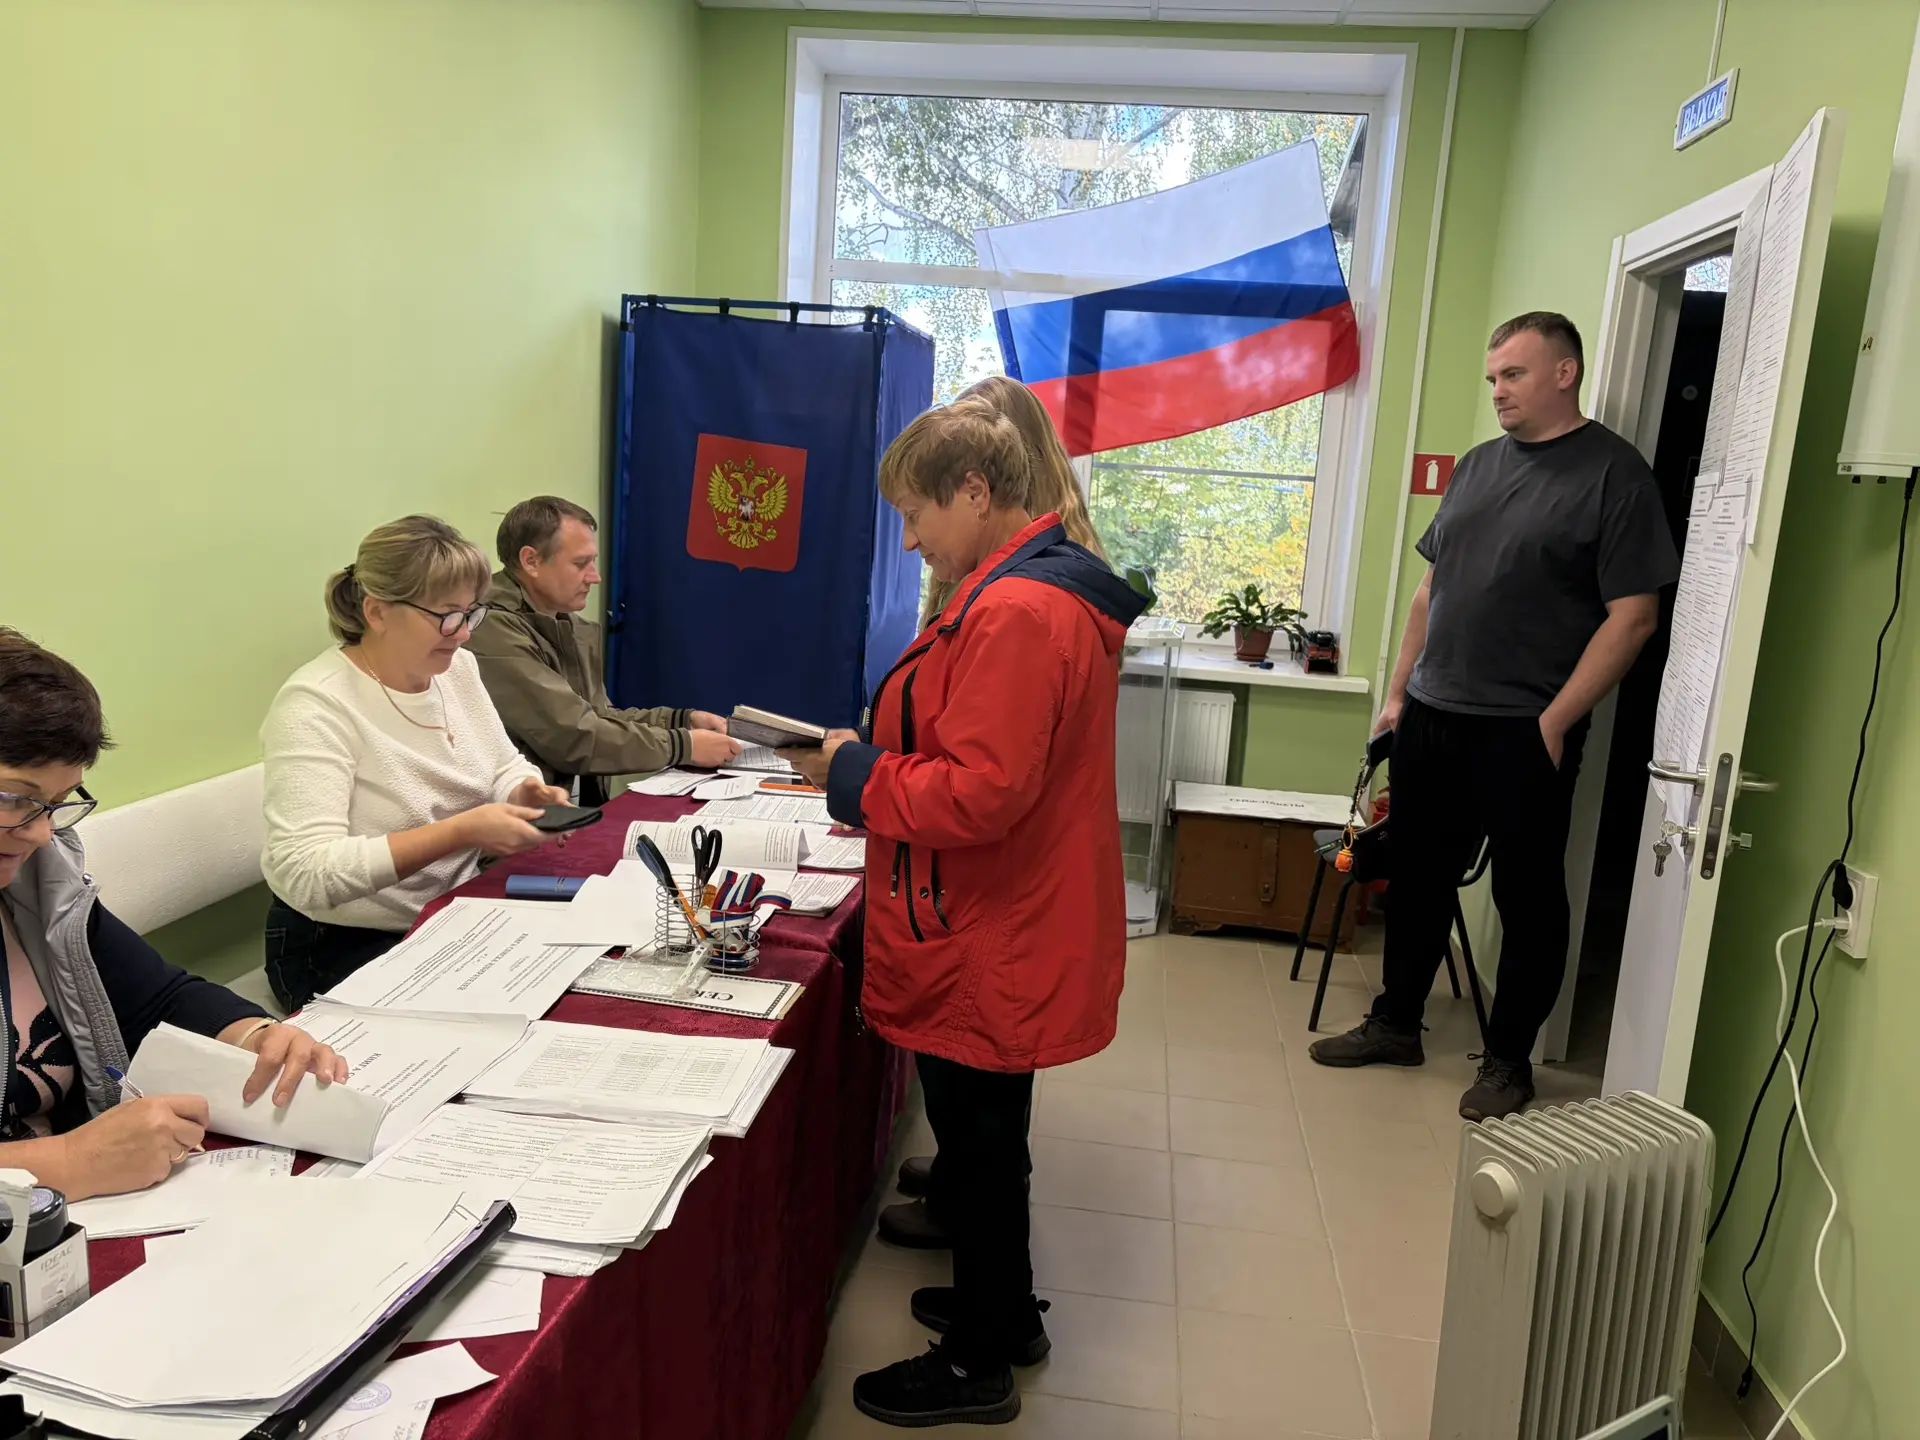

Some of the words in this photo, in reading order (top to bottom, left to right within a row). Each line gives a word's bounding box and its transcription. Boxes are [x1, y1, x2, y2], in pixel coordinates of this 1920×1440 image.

[1682, 85, 1727, 137] ВЫХОД
[352, 1052, 382, 1071] КНИГА
[41, 1246, 73, 1271] IDEAL
